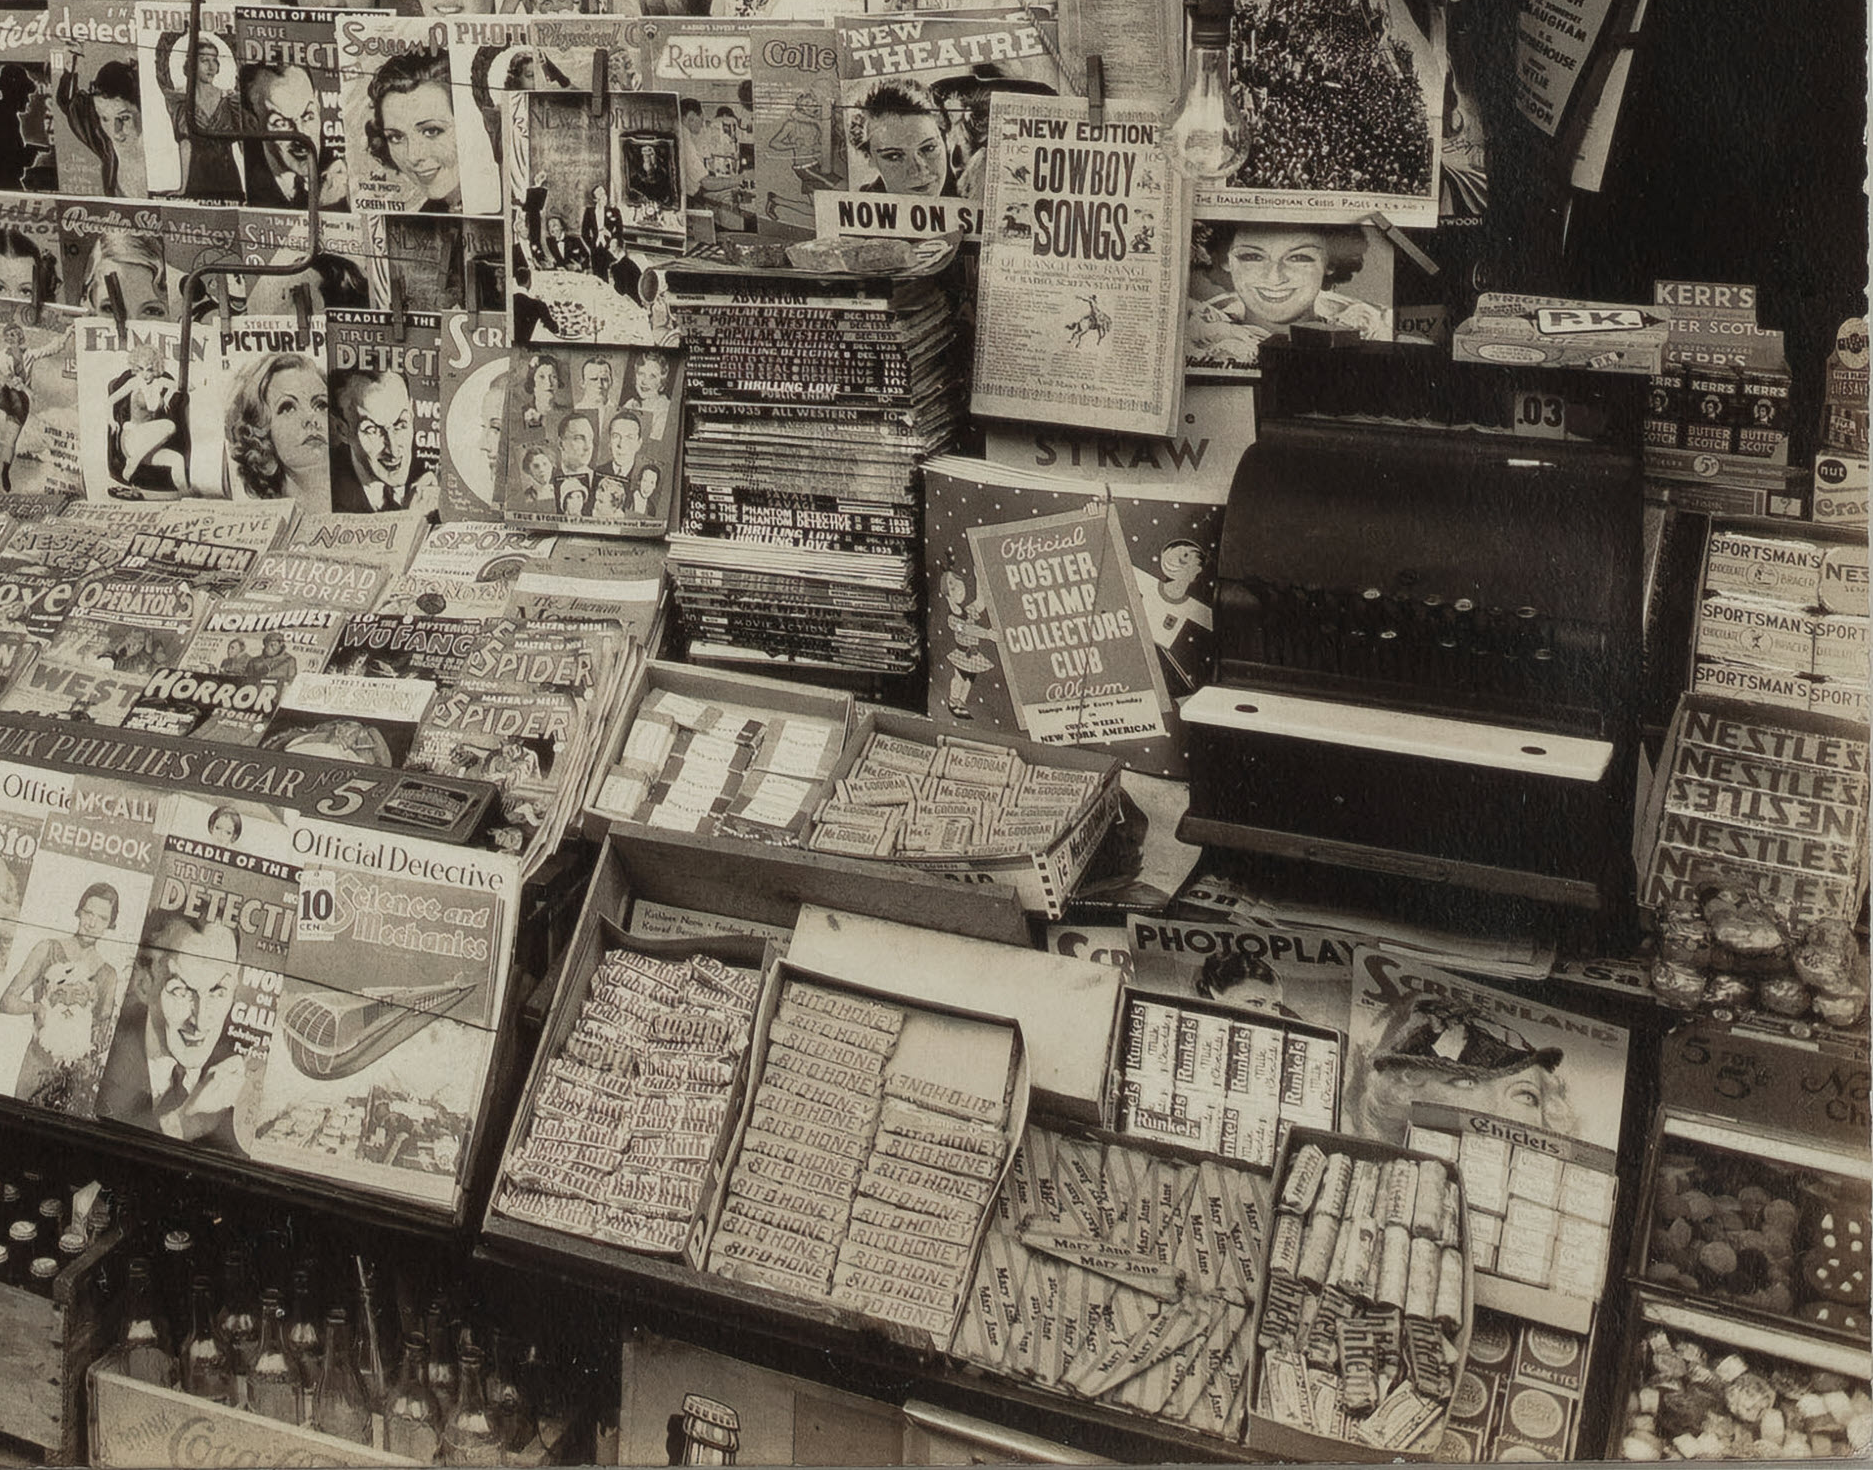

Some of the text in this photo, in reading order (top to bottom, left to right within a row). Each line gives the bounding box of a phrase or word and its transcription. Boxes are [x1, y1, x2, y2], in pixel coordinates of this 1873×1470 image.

[1018, 119, 1156, 145] NEW EDITION
[1032, 147, 1138, 198] COWBOY
[838, 201, 946, 232] NOW ON
[1032, 199, 1128, 262] SONGS
[1655, 284, 1755, 308] KERR'S
[700, 307, 834, 320] POPULAR DETECTIVE
[1549, 310, 1641, 327] P.K.
[736, 380, 840, 393] THRILLING LOVE
[1691, 380, 1736, 394] KERR'S
[1518, 397, 1564, 428] .03
[1687, 426, 1731, 439] BUTTER
[1687, 437, 1730, 451] SCOTCH
[1035, 434, 1210, 473] STRAW
[1000, 527, 1086, 559] Official
[1710, 538, 1821, 569] SPORTSMAN'S
[257, 555, 378, 591] RAILROAD
[1006, 552, 1097, 591] POSTER
[283, 579, 369, 606] STORIES
[1021, 587, 1095, 621] STAMP
[1006, 610, 1134, 654] COLLECTORS
[474, 639, 596, 689] SPIDER
[1050, 647, 1103, 680] CLUB
[142, 670, 278, 715] HORROR
[1044, 680, 1131, 704] Album
[1694, 665, 1809, 698] SPORTSMAN'S
[1040, 732, 1066, 743] NEW
[1102, 722, 1157, 737] AMERICAN
[1684, 710, 1864, 771] NESTLES
[200, 751, 306, 799] CIGAR
[1678, 745, 1859, 806] NESTLES
[48, 822, 152, 863] REDBOOK
[291, 827, 504, 891] Official Detective
[301, 889, 334, 921] 10
[333, 871, 490, 929] Science and
[349, 912, 489, 962] Mechanics
[1362, 953, 1618, 1045] SCREENLAND
[1469, 1116, 1563, 1156] Chiclets
[1054, 1237, 1131, 1256] Mary Jane
